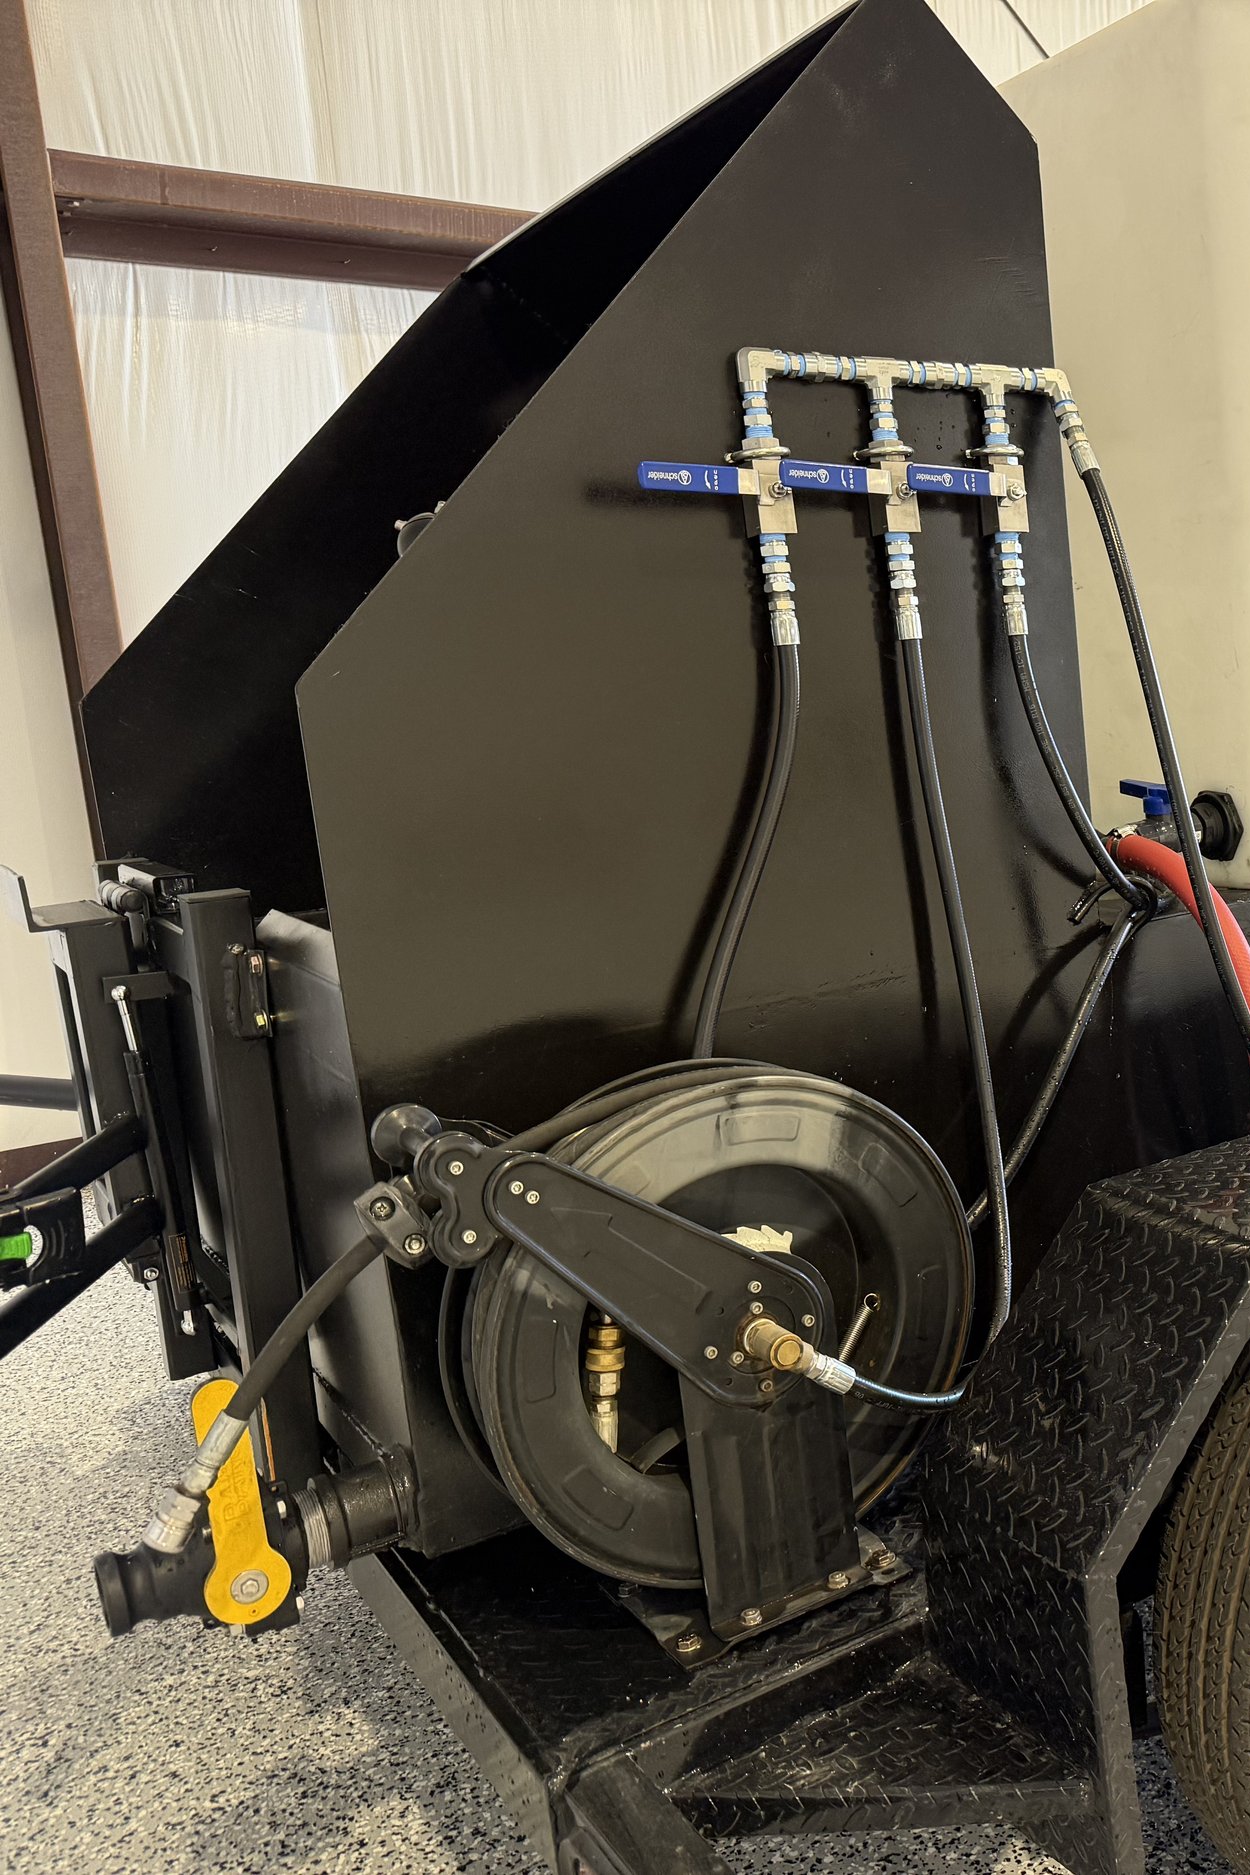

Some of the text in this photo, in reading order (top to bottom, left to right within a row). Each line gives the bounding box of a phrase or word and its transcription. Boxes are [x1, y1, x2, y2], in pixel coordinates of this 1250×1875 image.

[647, 471, 678, 481] schneider
[788, 469, 817, 479] schneider
[915, 472, 942, 483] schneider
